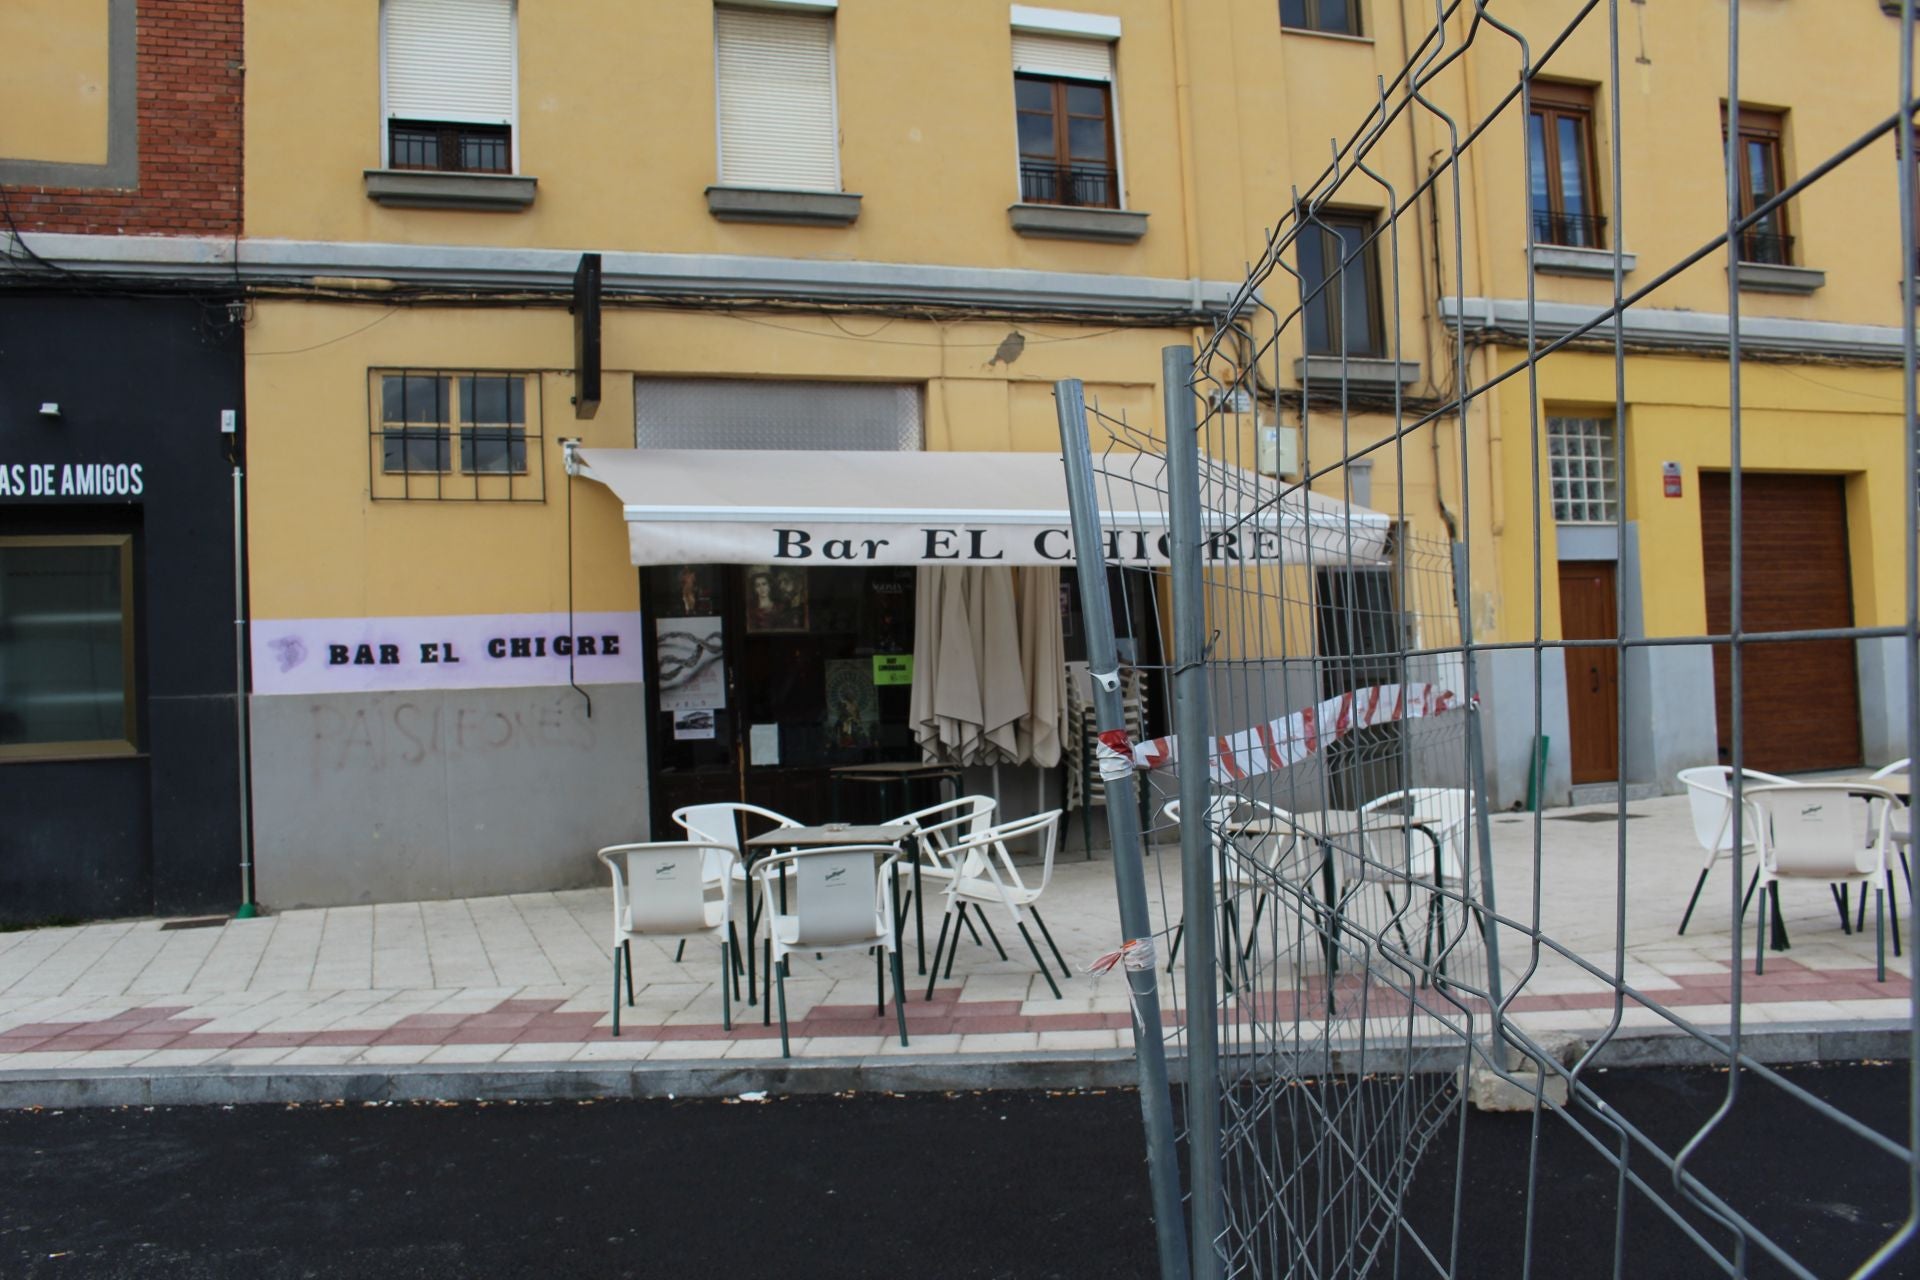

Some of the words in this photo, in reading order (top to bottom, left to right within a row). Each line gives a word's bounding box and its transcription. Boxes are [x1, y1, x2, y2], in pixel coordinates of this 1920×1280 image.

[0, 464, 25, 496] AS
[30, 464, 56, 496] DE
[61, 463, 144, 496] AMIGOS
[773, 528, 889, 560] Bar
[921, 528, 1004, 560] EL
[1034, 528, 1281, 561] CHIRE
[329, 644, 400, 665] BAR
[420, 643, 460, 663] EL
[487, 635, 620, 659] CHIGRE
